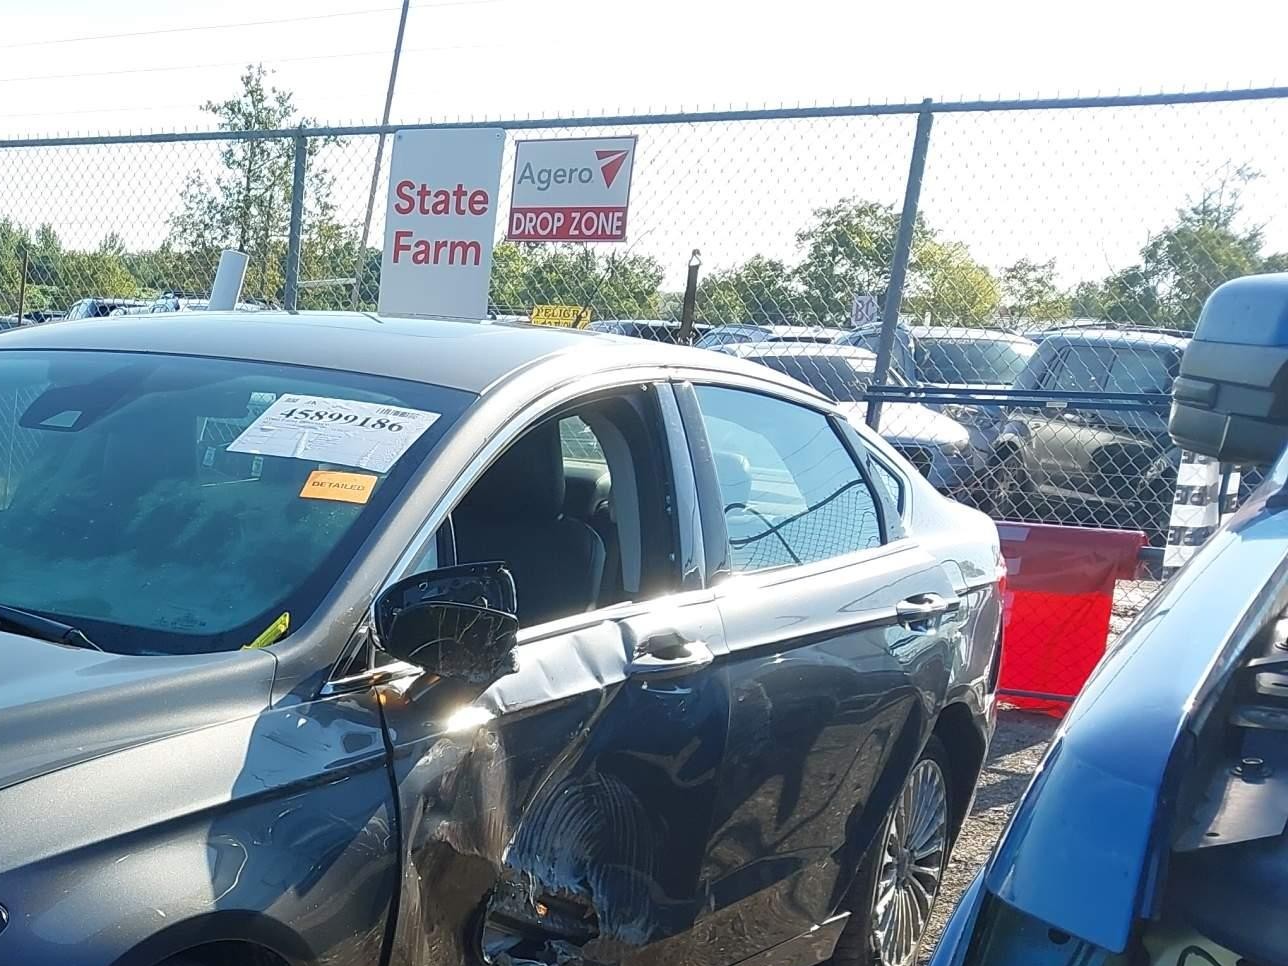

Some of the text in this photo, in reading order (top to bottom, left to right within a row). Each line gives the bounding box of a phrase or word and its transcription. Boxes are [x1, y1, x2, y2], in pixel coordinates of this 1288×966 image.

[517, 161, 594, 191] Agero
[394, 180, 489, 216] State
[511, 210, 624, 236] DROP ZONE
[392, 230, 482, 266] Farm
[536, 307, 589, 318] PELIGRO
[279, 406, 405, 433] 45899186
[310, 480, 367, 492] DETAILED
